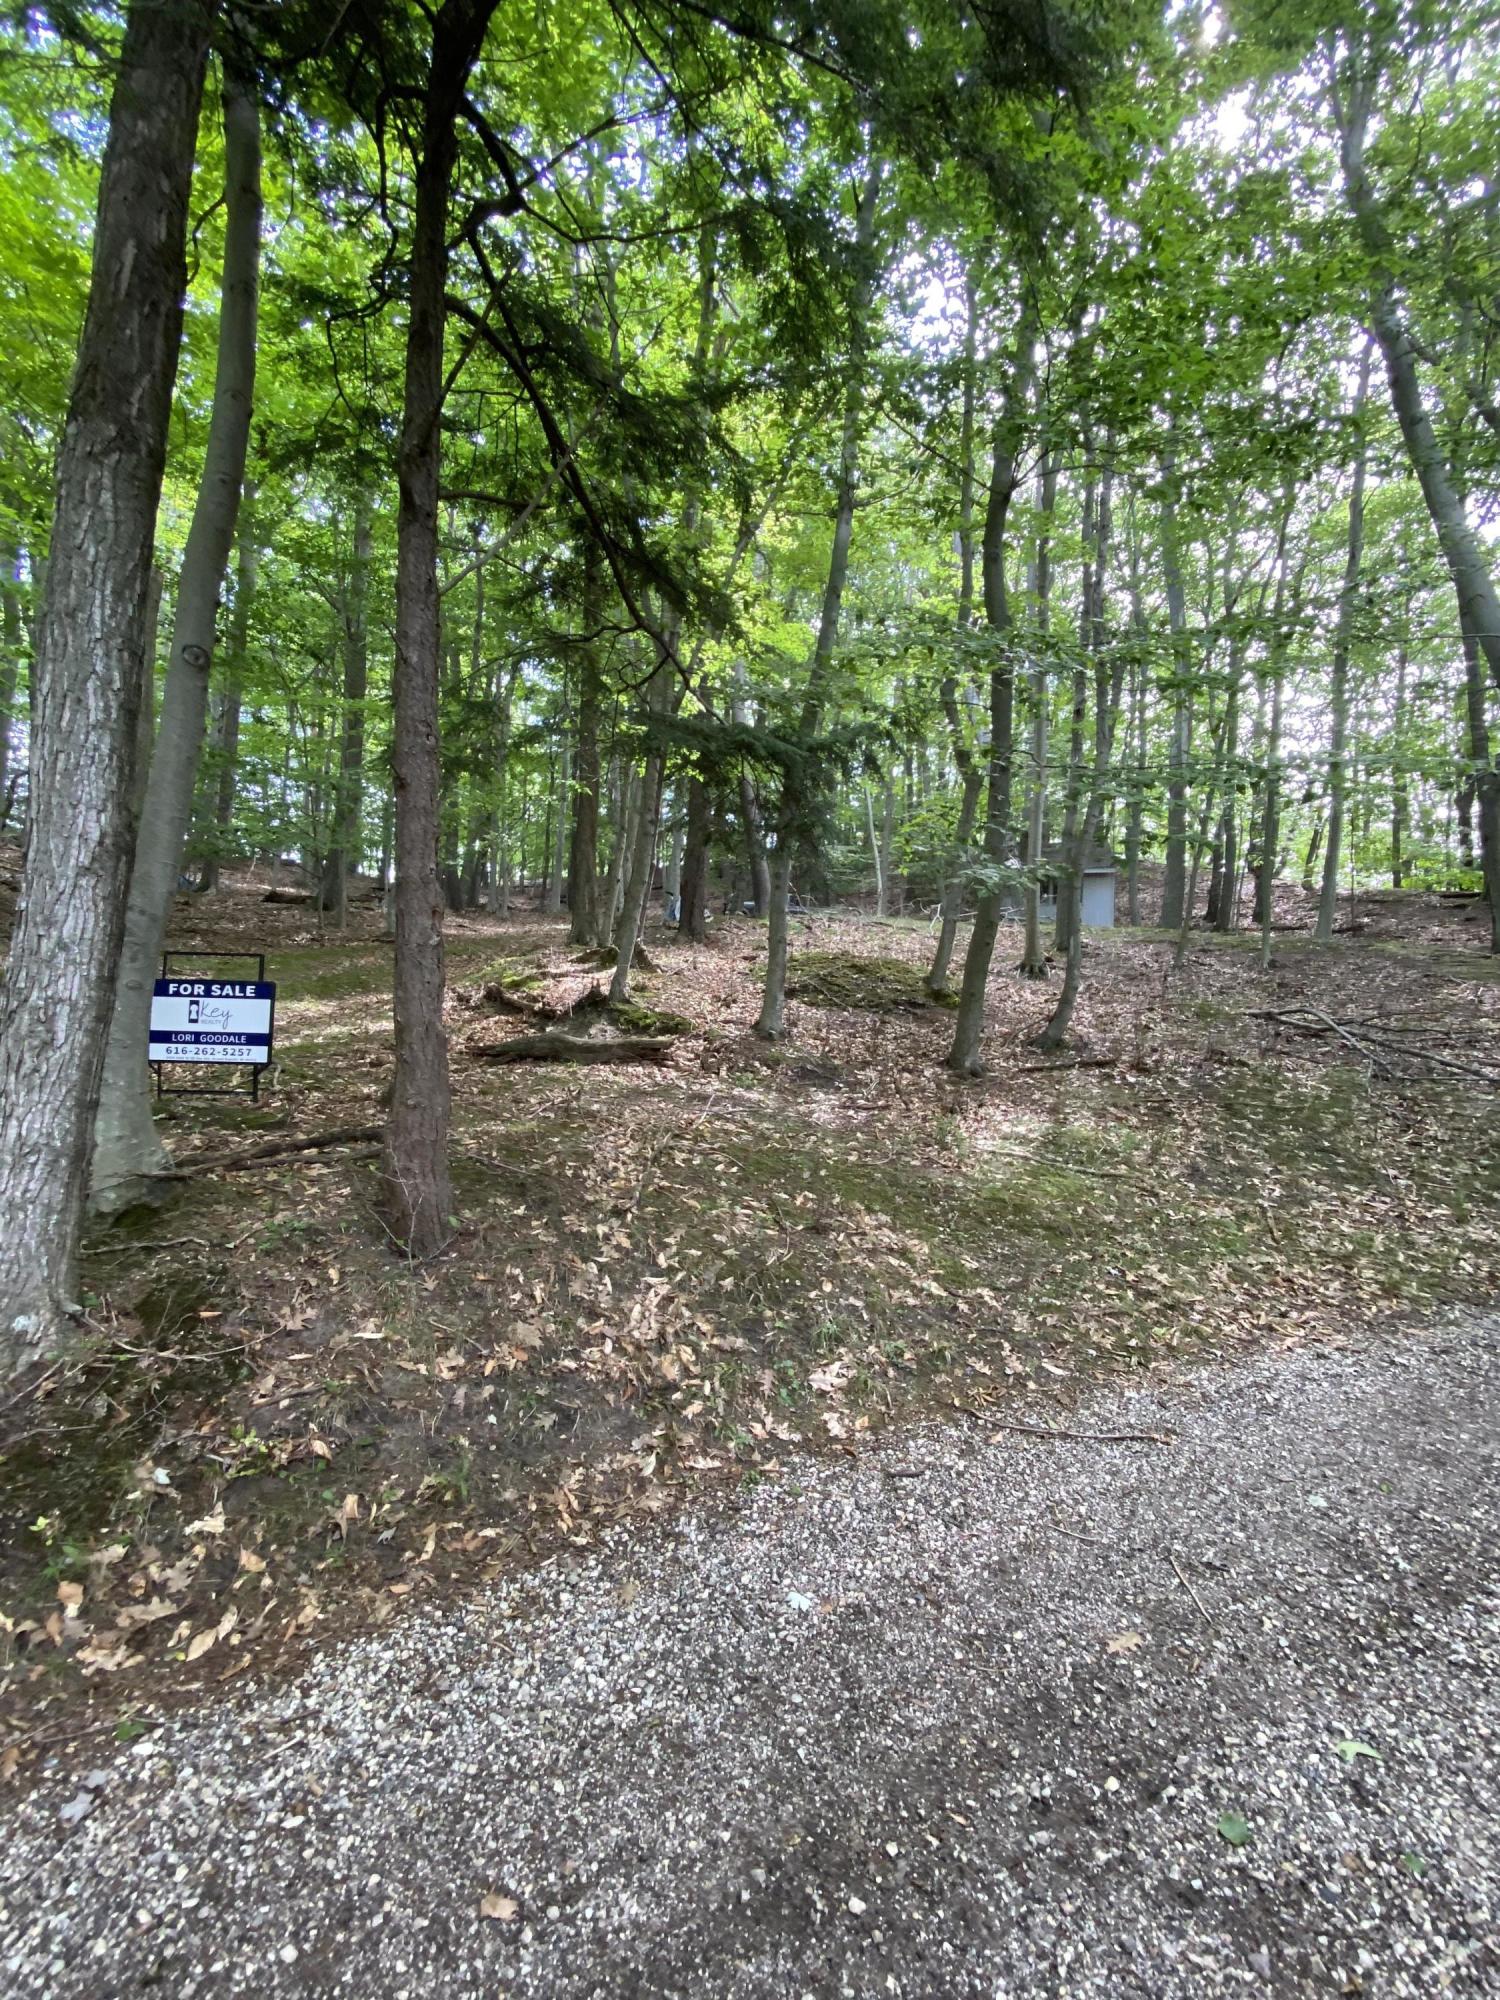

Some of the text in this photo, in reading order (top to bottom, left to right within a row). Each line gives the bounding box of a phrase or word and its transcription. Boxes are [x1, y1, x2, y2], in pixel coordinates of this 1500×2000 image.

[168, 984, 256, 997] FOR SALE
[201, 1000, 233, 1030] Key
[172, 1033, 247, 1044] LORI GOODALE
[166, 1046, 252, 1057] 616-262-5257
